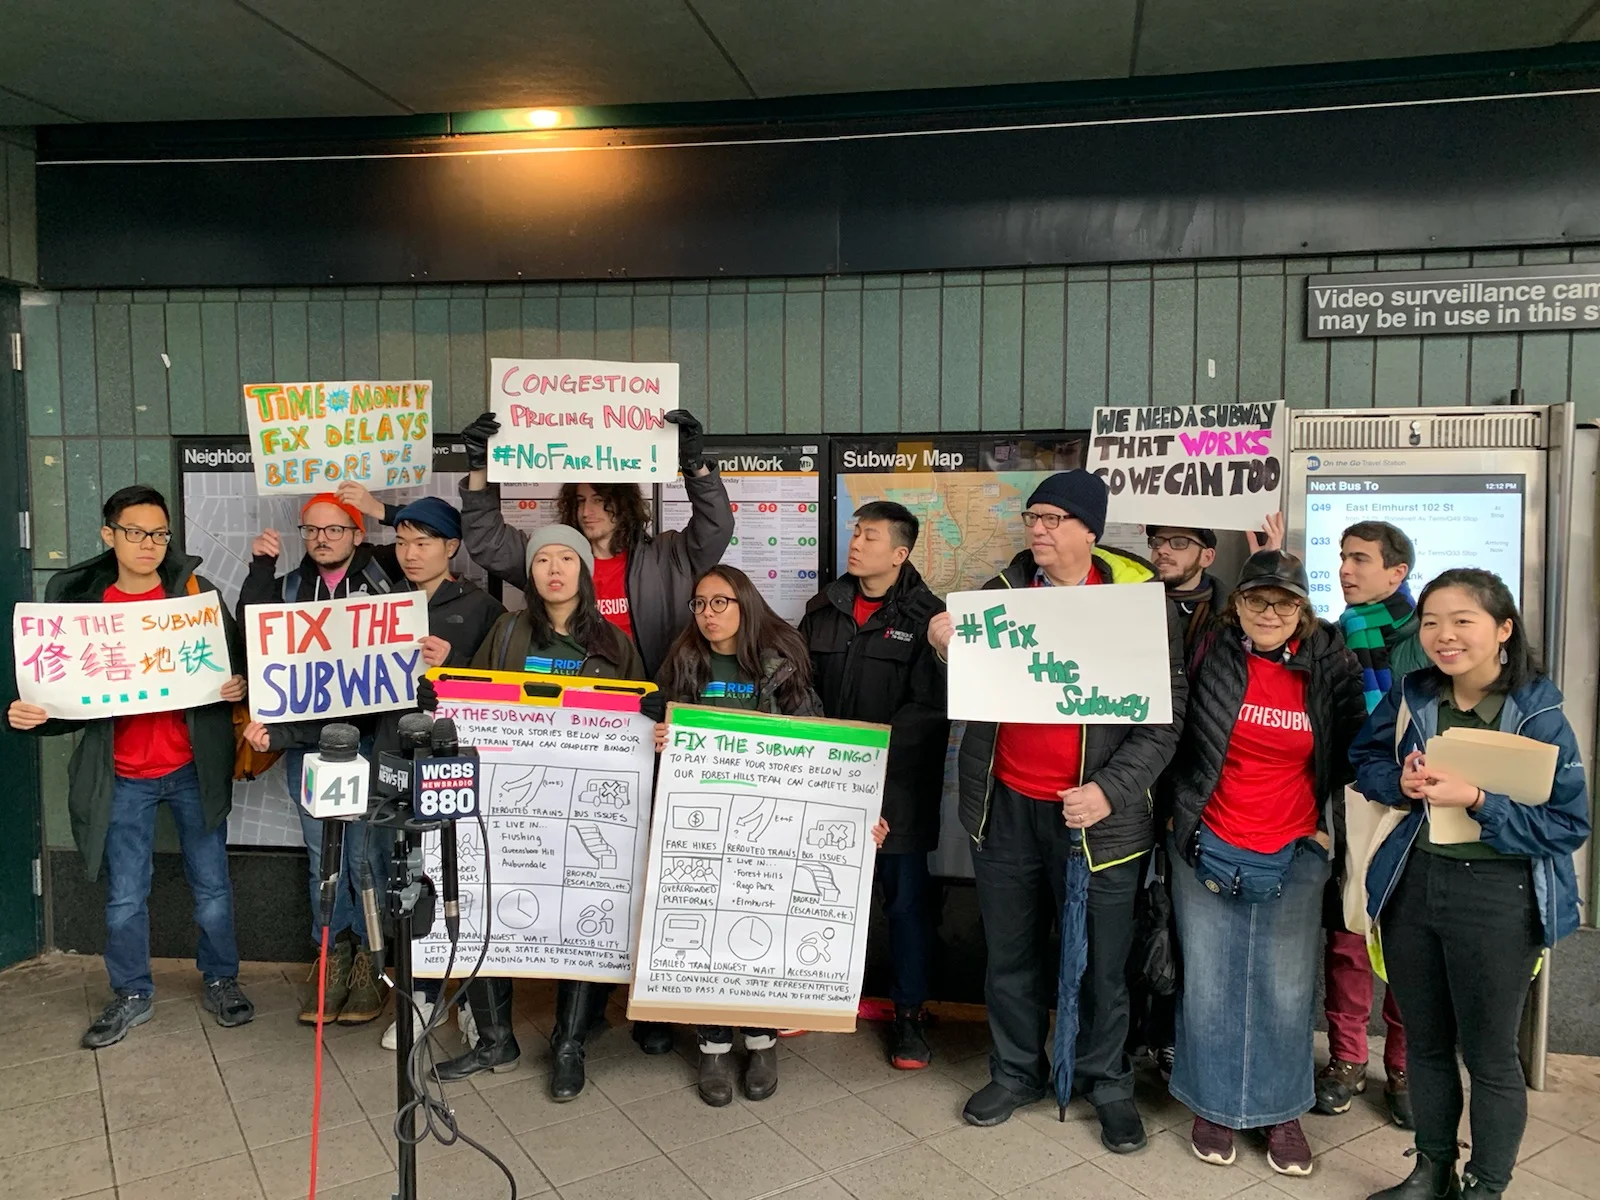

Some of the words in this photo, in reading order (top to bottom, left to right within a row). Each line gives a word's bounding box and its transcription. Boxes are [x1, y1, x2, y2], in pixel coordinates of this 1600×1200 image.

[1314, 288, 1385, 309] Video
[1391, 283, 1546, 305] surveillance
[1319, 312, 1370, 334] may
[1377, 309, 1406, 328] be
[1414, 307, 1436, 327] in
[1444, 308, 1490, 326] use
[1497, 304, 1520, 324] in
[1528, 302, 1577, 322] this
[1584, 304, 1600, 321] s
[502, 366, 660, 397] CONGESTION
[245, 384, 327, 422] TIME
[349, 384, 429, 415] MONEY
[510, 404, 594, 429] PRICING
[603, 405, 665, 430] NOW
[1097, 409, 1131, 435] WE
[1136, 407, 1184, 431] NEED
[1184, 407, 1199, 427] A
[1200, 403, 1276, 430] SUBWAY
[325, 412, 429, 447] DELAYS
[1094, 435, 1175, 460] THAT
[1179, 430, 1272, 457] WORKS
[184, 449, 254, 467] Neighbor
[265, 452, 371, 486] BEFORE
[381, 444, 412, 465] WE
[740, 456, 783, 471] Work
[843, 450, 917, 470] Subway
[923, 449, 964, 470] Map
[386, 465, 426, 485] PAY
[1128, 465, 1165, 494] WE
[1164, 462, 1223, 496] CAN
[1228, 457, 1280, 495] TOO
[1311, 481, 1336, 491] Next
[1339, 481, 1361, 491] Bus
[1364, 481, 1379, 491] To
[1311, 503, 1331, 512] Q49
[1346, 503, 1368, 512] East
[1372, 503, 1418, 512] Elmhurst
[1422, 503, 1440, 512] 102
[1443, 503, 1454, 512] St
[1311, 537, 1331, 546] Q33
[1311, 571, 1330, 580] Q70
[1310, 584, 1331, 593] SBS
[20, 615, 67, 639] FIX
[72, 613, 125, 636] THE
[142, 605, 219, 631] SUBWAY
[259, 607, 332, 655] FIX
[346, 600, 414, 648] THE
[955, 603, 1039, 649] #Fix
[1027, 651, 1080, 683] the
[257, 648, 420, 717] SUBWAY
[1056, 684, 1150, 722] Subway
[433, 706, 459, 720] FIX
[462, 708, 488, 720] THE
[492, 710, 556, 726] SUBWAY
[1238, 703, 1313, 732] THESUBW
[468, 725, 498, 733] SHARE
[501, 728, 524, 736] YOUR
[528, 729, 562, 737] STORIES
[566, 730, 600, 739] BELOW
[605, 733, 617, 741] SO
[620, 735, 640, 744] OUR
[484, 738, 508, 746] TRAIN
[512, 739, 534, 747] TEAM
[560, 742, 599, 751] COMPLETE
[674, 730, 707, 751] FIX
[714, 734, 748, 753] THE
[756, 741, 815, 759] SUBWAY
[828, 748, 880, 767] BINGO!
[421, 762, 474, 780] WCBS
[670, 753, 682, 763] TO
[713, 756, 741, 766] SHARE
[745, 759, 765, 770] YOUR
[769, 762, 803, 774] STORIES
[809, 765, 842, 776] BELOW
[848, 769, 861, 778] SO
[422, 780, 473, 789] NEWSRADIO
[674, 769, 694, 778] OUR
[701, 770, 730, 780] FOREST
[733, 772, 754, 782] HILLS
[757, 774, 781, 785] TEAM
[787, 778, 804, 786] CAN
[807, 780, 847, 792] COMPLETE
[852, 781, 878, 796] BINGO!
[320, 776, 360, 806] 41
[420, 788, 474, 816] 880
[533, 807, 563, 817] TRAINS
[574, 810, 589, 818] BUS
[594, 811, 628, 823] ISSUES
[506, 821, 525, 829] LIVE
[501, 832, 542, 847] Flushing
[666, 840, 688, 849] FARE
[693, 842, 717, 850] HIKES
[541, 848, 555, 856] Hill
[727, 843, 766, 855] REROUTED
[768, 848, 796, 858] TRAINS
[802, 851, 814, 859] BUS
[819, 853, 847, 865] ISSUES
[501, 858, 547, 869] Auburndale
[566, 869, 598, 879] BROKEN
[737, 868, 761, 877] Forest
[763, 871, 783, 880] Hills
[661, 884, 717, 893] OVERCROWDED
[736, 881, 754, 894] Rego
[756, 881, 775, 891] Park
[663, 894, 714, 906] PLATFORMS
[736, 897, 776, 907] Elmhurst
[793, 895, 820, 905] BROKEN
[523, 935, 549, 943] WAIT
[515, 946, 540, 954] STATE
[544, 946, 614, 959] REPRESENTATIVES
[564, 958, 577, 966] FIX
[578, 960, 594, 968] OUR
[653, 958, 685, 969] STALLED
[713, 961, 747, 971] LONGEST
[753, 966, 776, 975] WAIT
[787, 967, 846, 980] ACCESSABILITY
[676, 974, 719, 984] CONVINCE
[723, 977, 741, 986] OUR
[745, 978, 770, 987] STATE
[773, 980, 849, 993] REPRESENTATIVES
[647, 985, 659, 993] WE
[662, 985, 681, 993] NEED
[695, 986, 715, 994] PASS
[729, 988, 766, 998] FUNDING
[768, 991, 788, 999] PLAN
